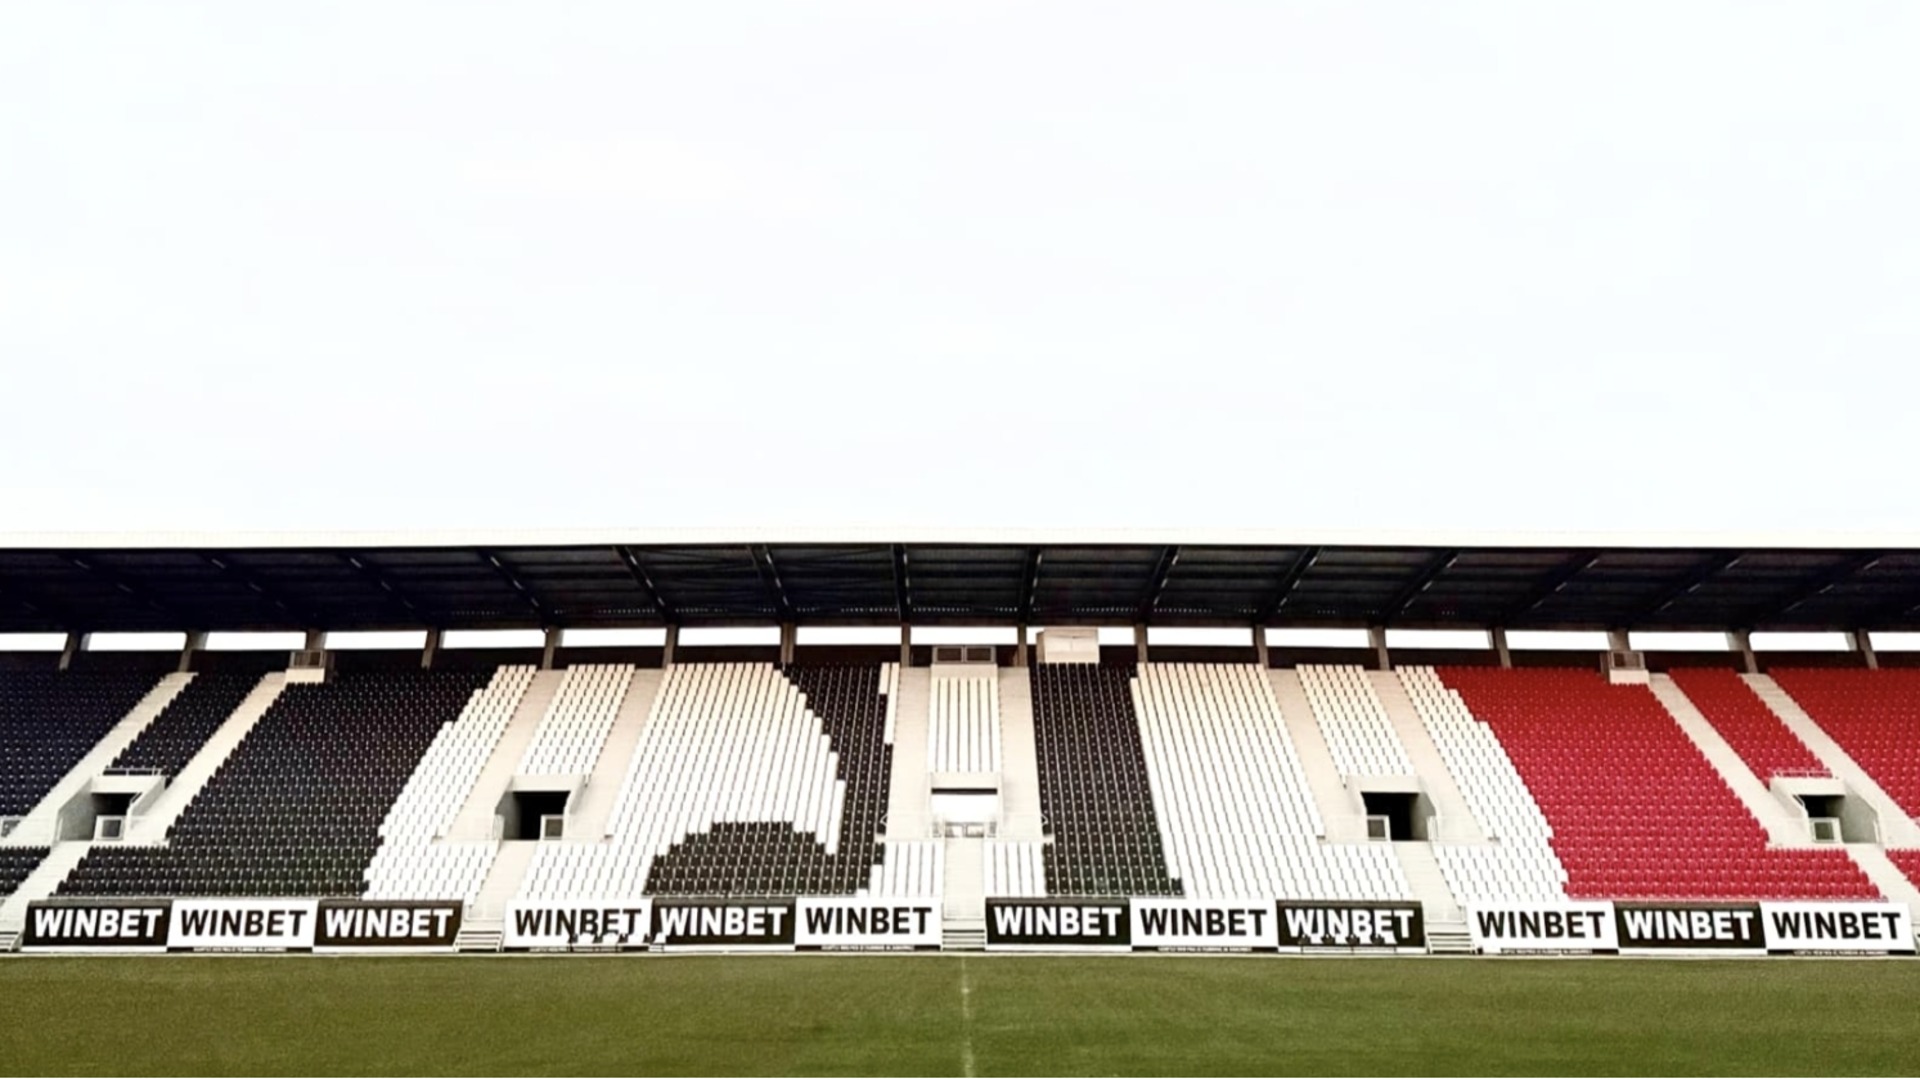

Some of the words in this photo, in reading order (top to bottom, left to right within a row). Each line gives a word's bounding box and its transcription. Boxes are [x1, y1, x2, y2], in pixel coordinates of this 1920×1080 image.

[34, 908, 163, 938] WINBET
[180, 909, 308, 937] WINBET
[325, 908, 455, 938] WINBET
[514, 908, 642, 937] WINBET
[659, 906, 789, 936] WINBET
[805, 906, 932, 935] WINBET
[993, 906, 1122, 937] WINBET
[1140, 908, 1268, 937] WINBET
[1284, 908, 1415, 938] WINBET
[1476, 911, 1606, 939] WINBET
[1623, 910, 1754, 940] WINBET
[1771, 912, 1901, 940] WINBET
